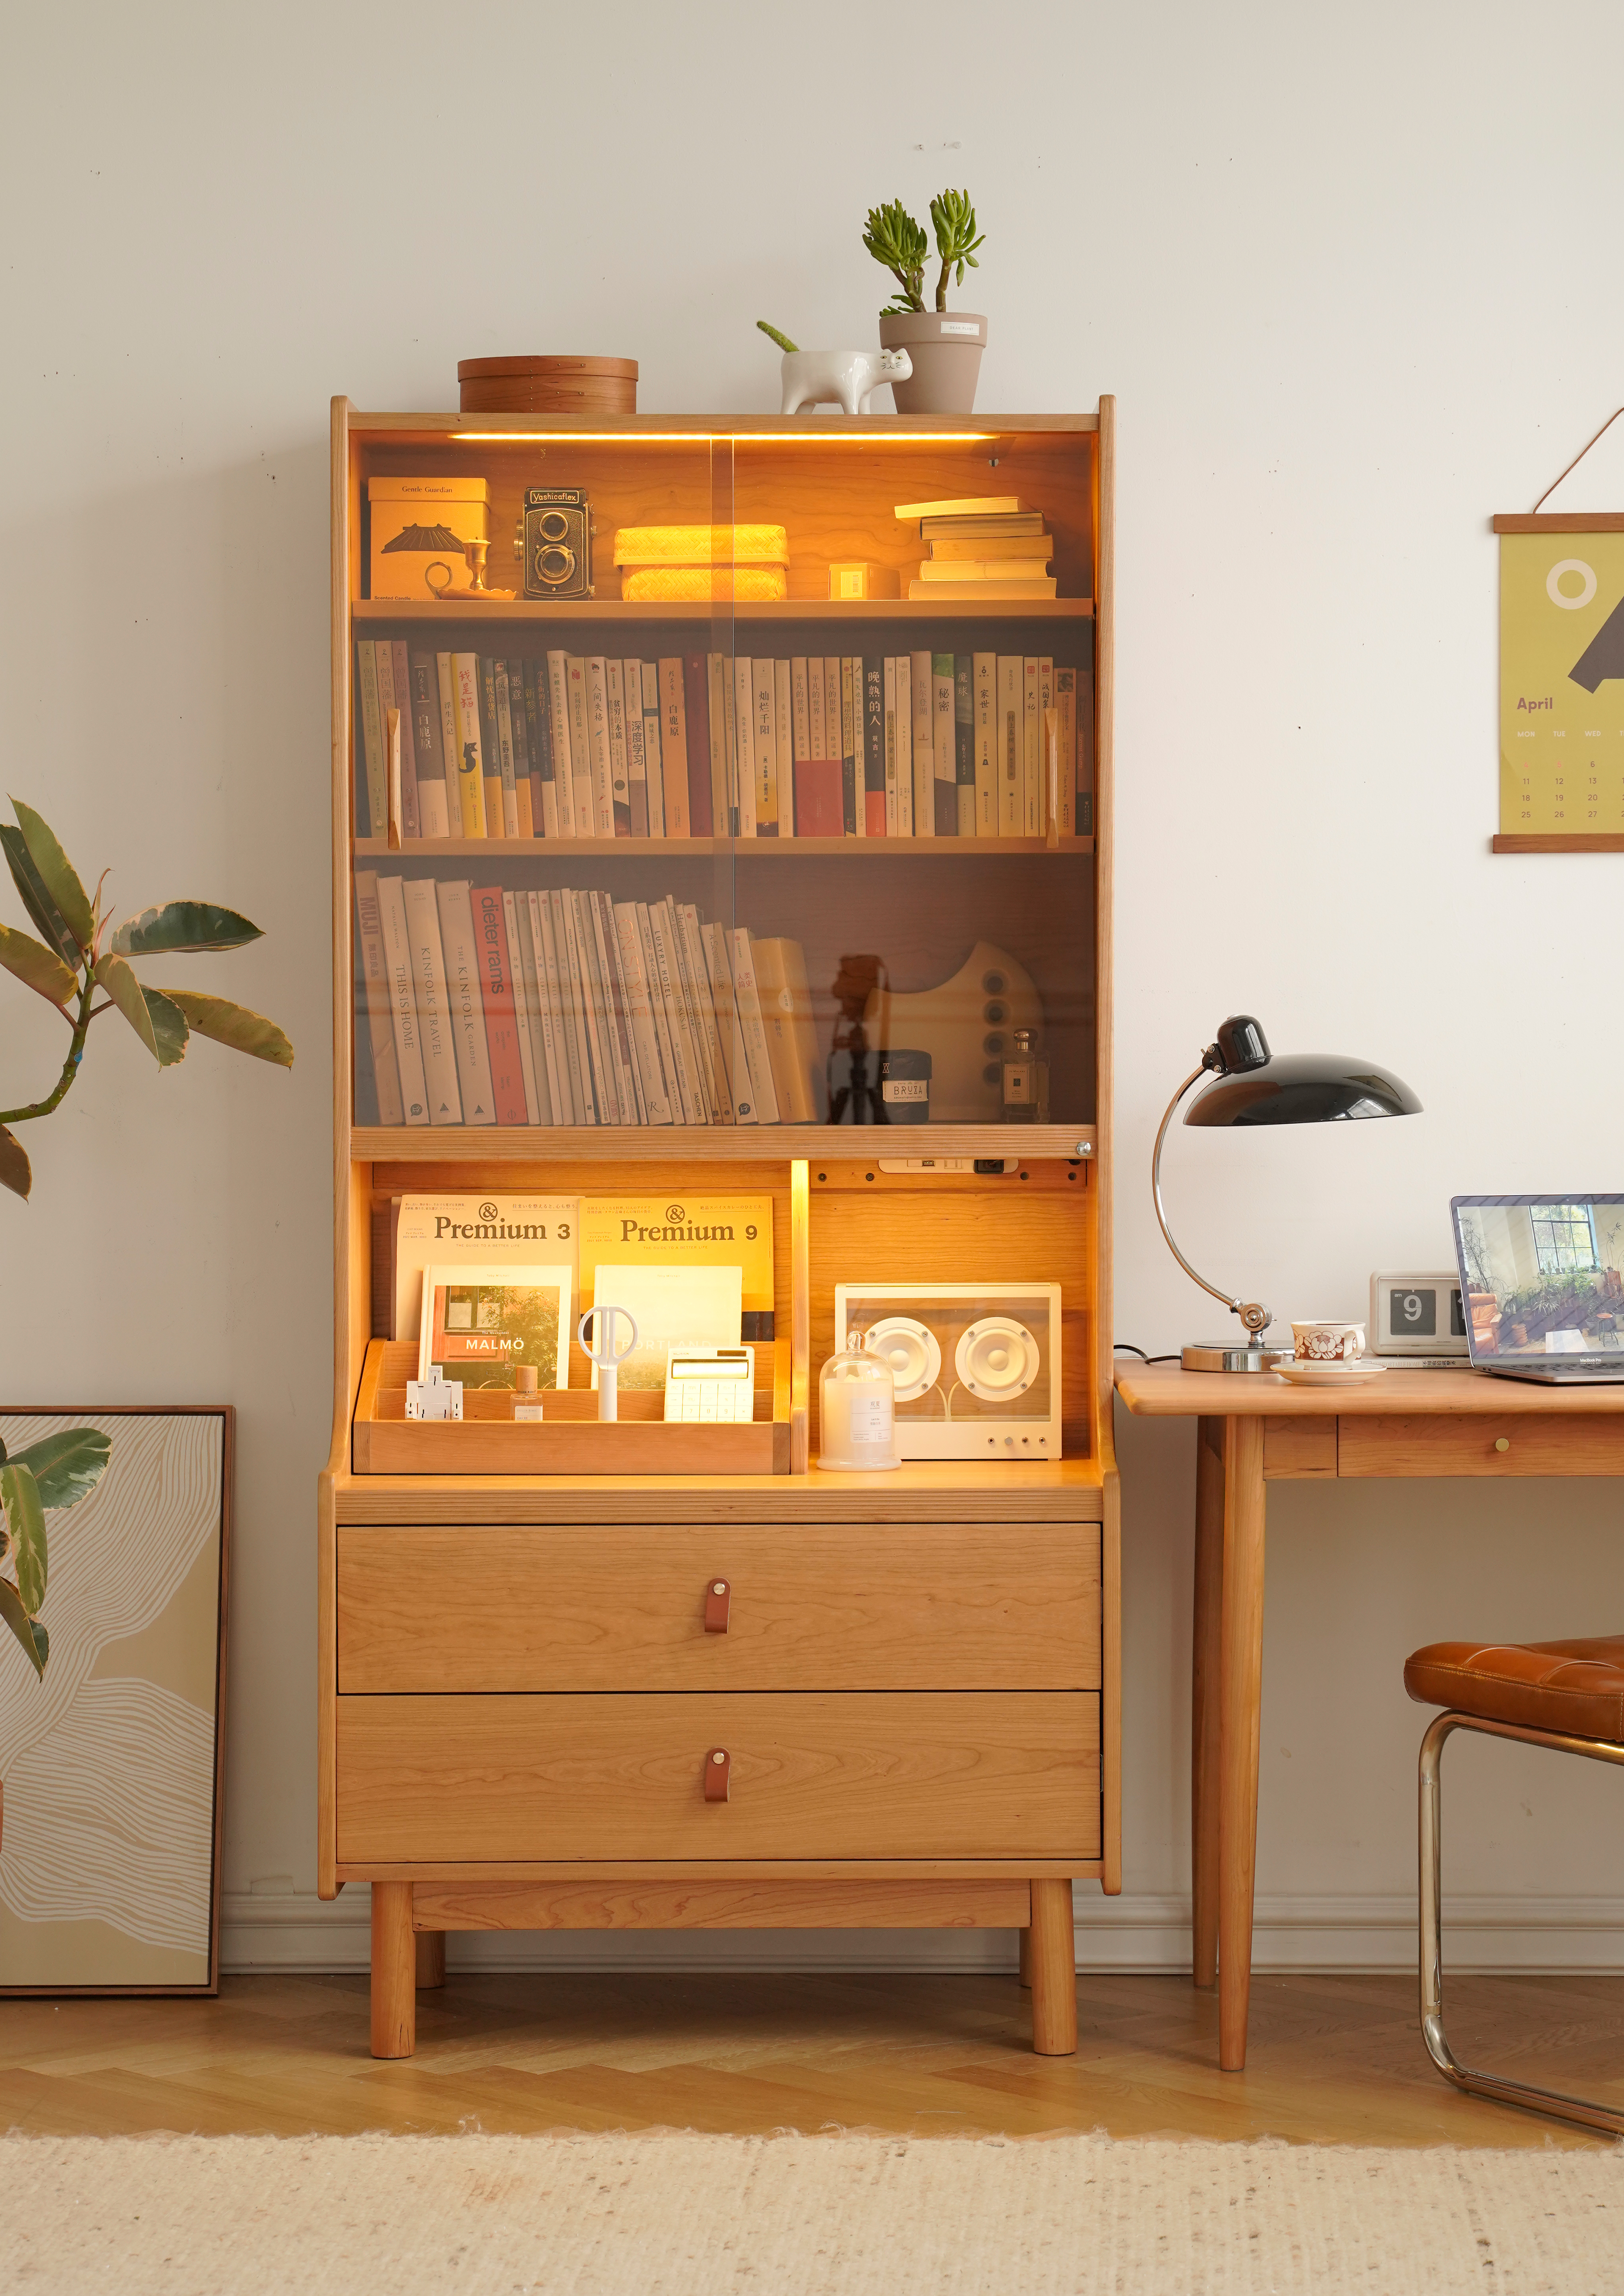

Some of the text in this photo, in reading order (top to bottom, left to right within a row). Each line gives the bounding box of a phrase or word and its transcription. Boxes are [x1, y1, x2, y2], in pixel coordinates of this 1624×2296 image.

[533, 493, 576, 502] Yashicaflex
[363, 667, 375, 699] 曾国藩
[381, 667, 392, 700] 曾国藩
[459, 669, 474, 708] 我是猫
[486, 677, 495, 720] 解忧杂货店
[511, 676, 521, 700] 恶意
[537, 671, 545, 715] 学生街的日子
[796, 674, 805, 715] 平凡的世界
[812, 674, 820, 715] 平凡的世界
[828, 674, 837, 715] 平凡的世界
[868, 671, 881, 727] 晚熟的人
[919, 680, 927, 716] 瓦尔登湖
[938, 688, 949, 712] 秘密
[957, 672, 968, 697] 魔球
[980, 689, 990, 708] 家世
[1027, 691, 1035, 710] 史记
[444, 702, 454, 735] 浮生六记
[525, 688, 536, 723] 新参者
[554, 672, 564, 745] 蛤蟆先生去看心理医生
[592, 684, 604, 722] 人间失格
[613, 699, 623, 740] 贫穷的本质
[669, 704, 679, 737] 白鹿原
[759, 691, 769, 735] 灿烂千阳
[1517, 697, 1552, 713] April
[419, 714, 431, 750] 白鹿原
[631, 721, 643, 765] 深度学习
[502, 740, 510, 767] 东野圭吾
[360, 896, 378, 935] MUJI
[481, 896, 505, 995] dieter rams
[676, 914, 688, 954] Herbarium
[368, 943, 379, 977] 無印良品
[618, 919, 648, 1019] ON STYLE
[654, 931, 666, 964] LUXYRY
[662, 970, 672, 999] HOTEL
[710, 940, 726, 990] Scented Life
[737, 971, 751, 981] 人类
[395, 964, 414, 1050] THIS IS HOME
[421, 947, 442, 1058] KINFOLK TRAVEL
[457, 966, 475, 1032] KINFOLK
[467, 1034, 477, 1067] GARDEN
[675, 996, 688, 1030] HOKUSAI
[752, 1016, 762, 1049] 从动物到上帝
[694, 1092, 703, 1117] TASCHEN
[434, 1217, 570, 1239] Premium 3
[620, 1220, 757, 1241] Premium 9
[1404, 1295, 1422, 1321] 9
[466, 1338, 524, 1350] MALMÖ
